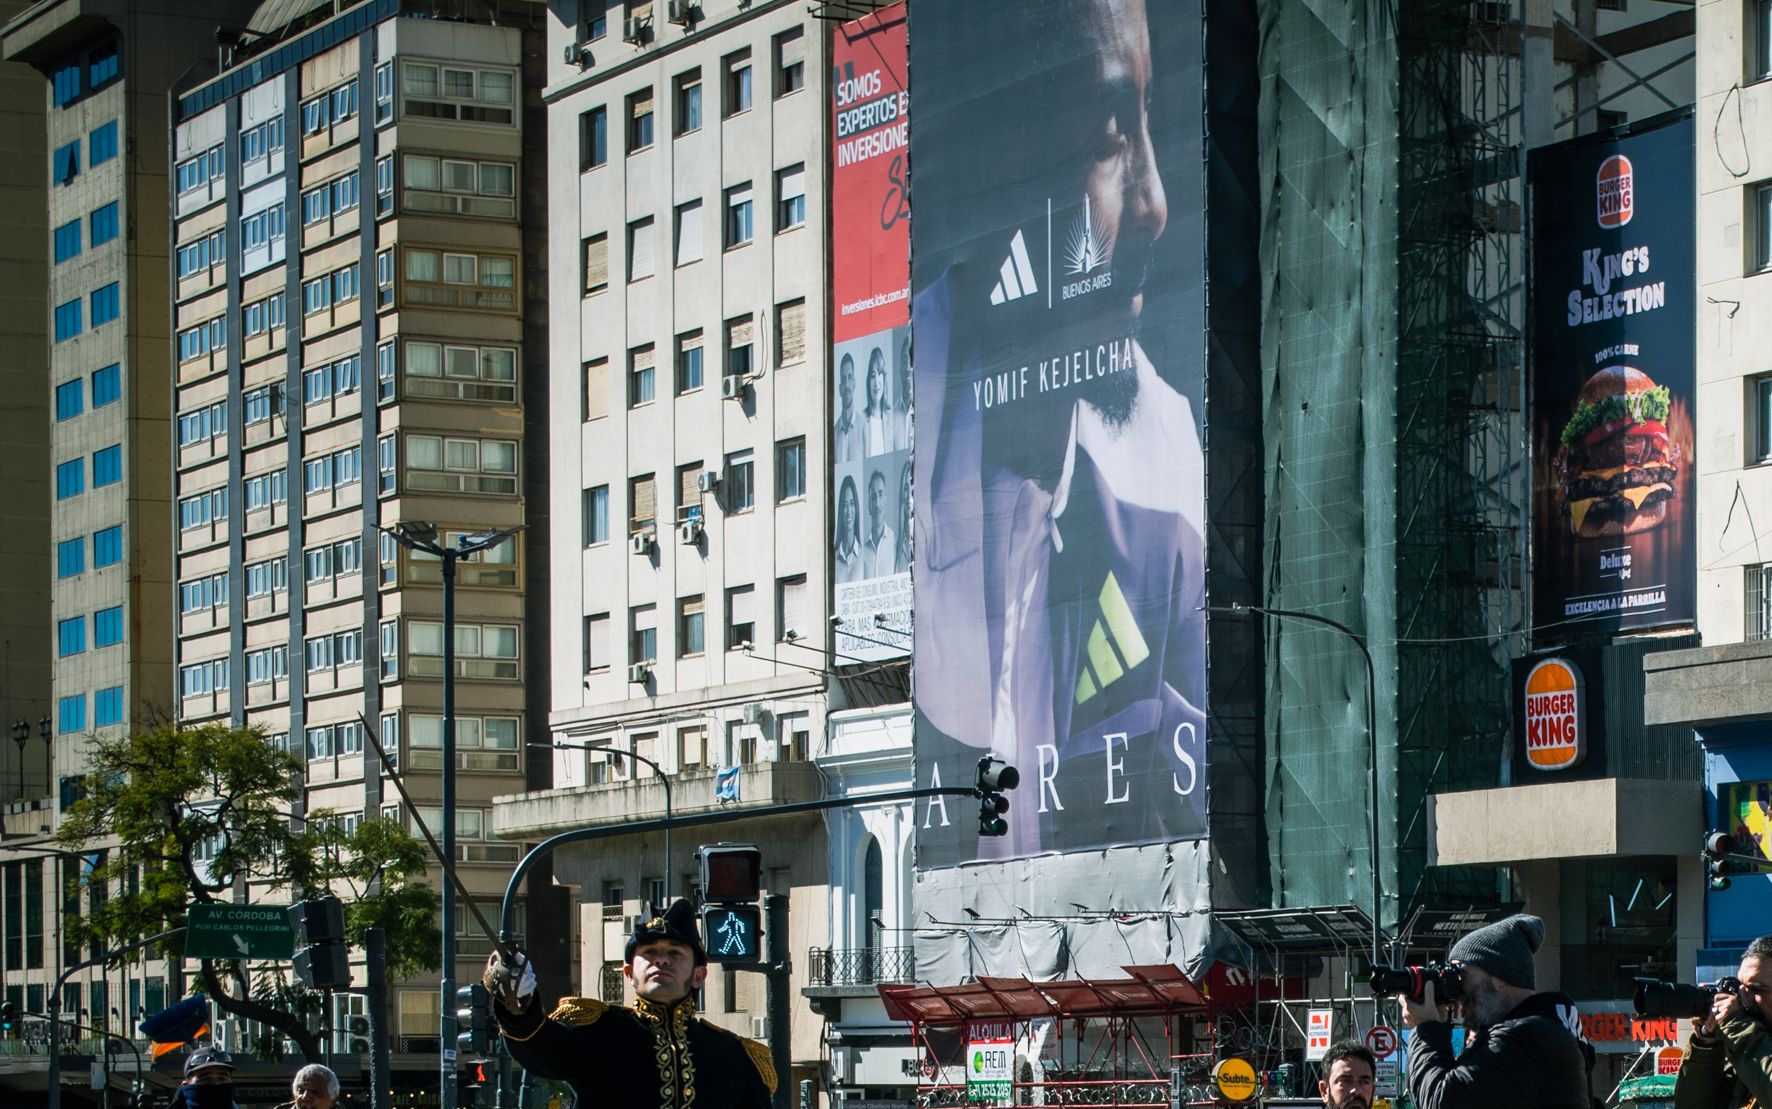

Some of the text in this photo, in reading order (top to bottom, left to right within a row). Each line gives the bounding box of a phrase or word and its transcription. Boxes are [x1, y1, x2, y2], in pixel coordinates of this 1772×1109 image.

[837, 69, 881, 106] SOMOS
[838, 95, 897, 138] EXPERTOS
[1600, 176, 1631, 195] BURGER
[1600, 191, 1631, 215] KING
[1063, 272, 1112, 300] BUENOS AIRES
[1567, 282, 1665, 327] SELECTION
[1595, 344, 1639, 364] 100% CARNE
[973, 338, 1133, 410] YOMIF KEJELCHA
[1600, 554, 1632, 570] Deluxe
[1565, 599, 1610, 616] EXCELENCIA
[1618, 596, 1628, 609] LA
[1628, 591, 1666, 607] PARRILLA
[1527, 693, 1575, 717] BURGER
[1528, 715, 1575, 747] KING
[208, 910, 224, 920] AV.
[213, 923, 244, 931] CARLOS
[969, 1024, 1011, 1042] ALQUILA
[1631, 1015, 1677, 1041] KING
[985, 1051, 1006, 1068] REM
[1222, 1073, 1250, 1083] Subte
